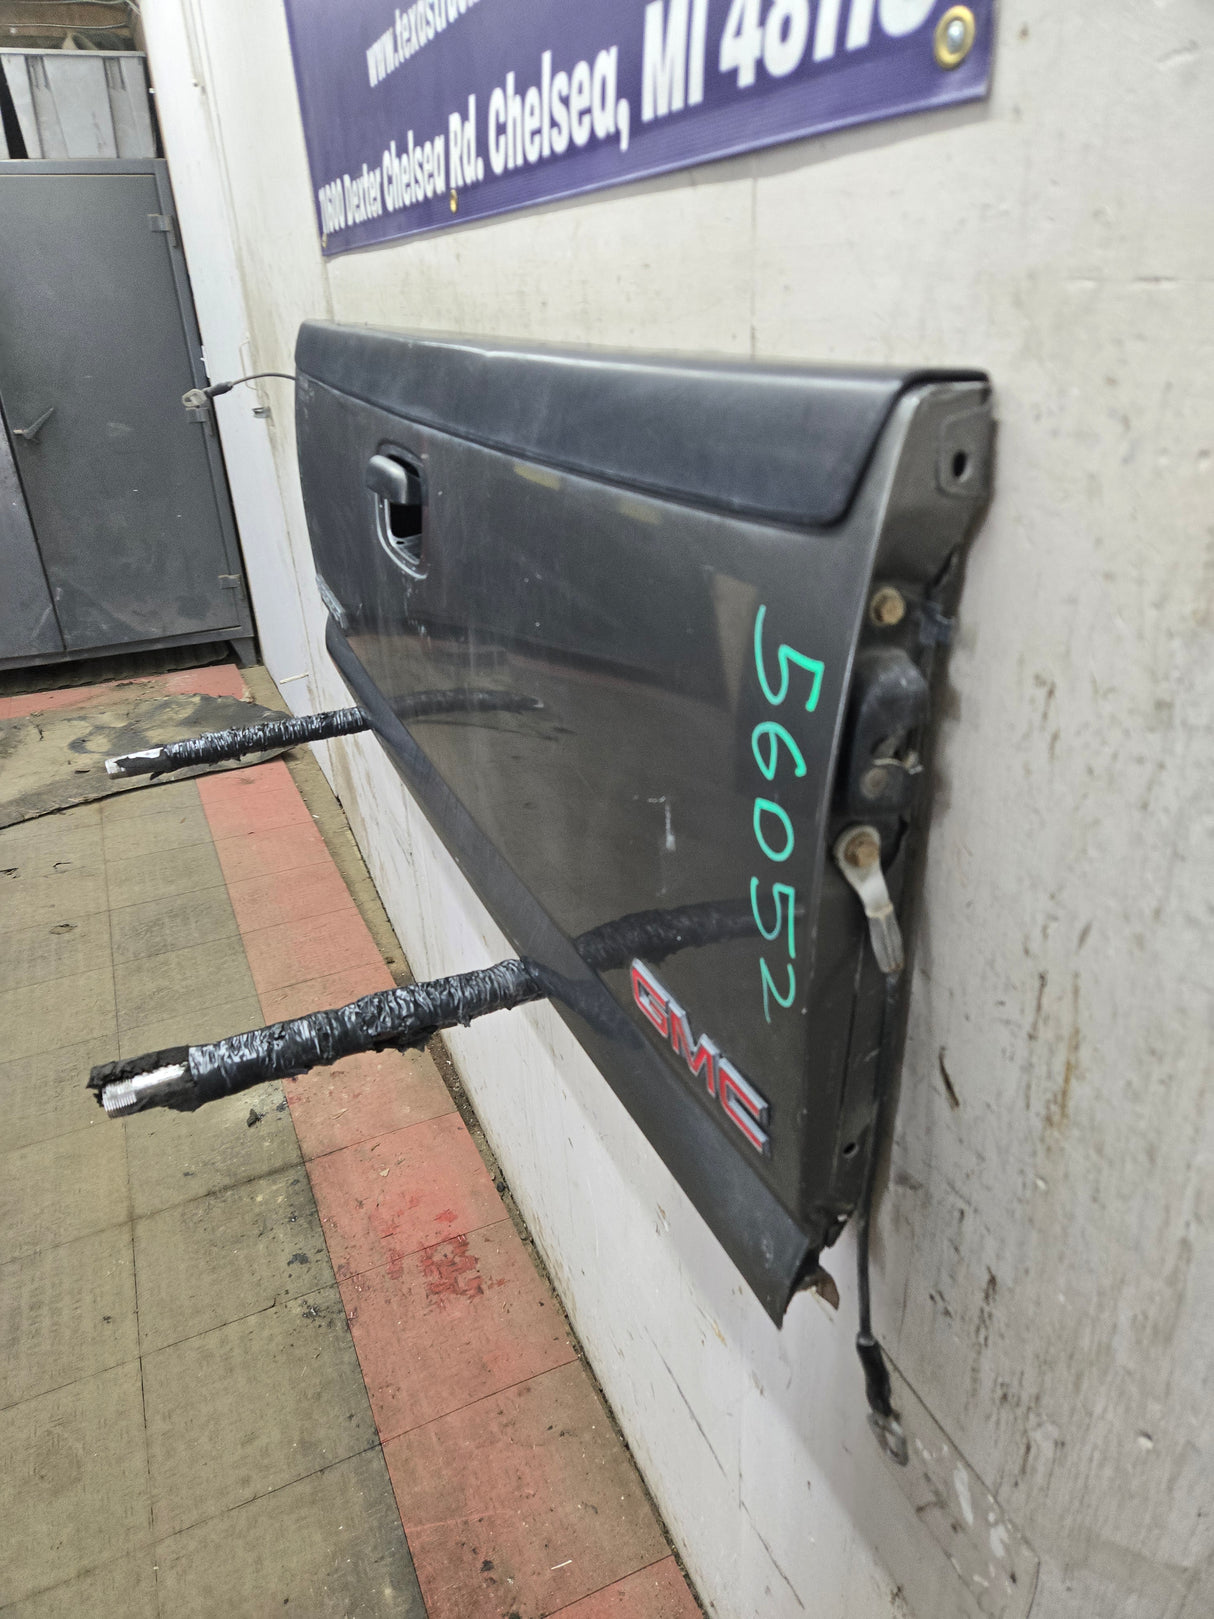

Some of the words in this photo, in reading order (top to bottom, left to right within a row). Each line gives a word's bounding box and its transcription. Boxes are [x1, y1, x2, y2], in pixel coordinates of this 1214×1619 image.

[343, 163, 382, 226] Dexter
[382, 130, 446, 213] Chelsea
[449, 94, 485, 188] Rd.
[488, 44, 631, 176] Chelsea,
[641, 0, 708, 123] MI
[751, 604, 825, 1024] 56052
[631, 957, 770, 1157] GMC
